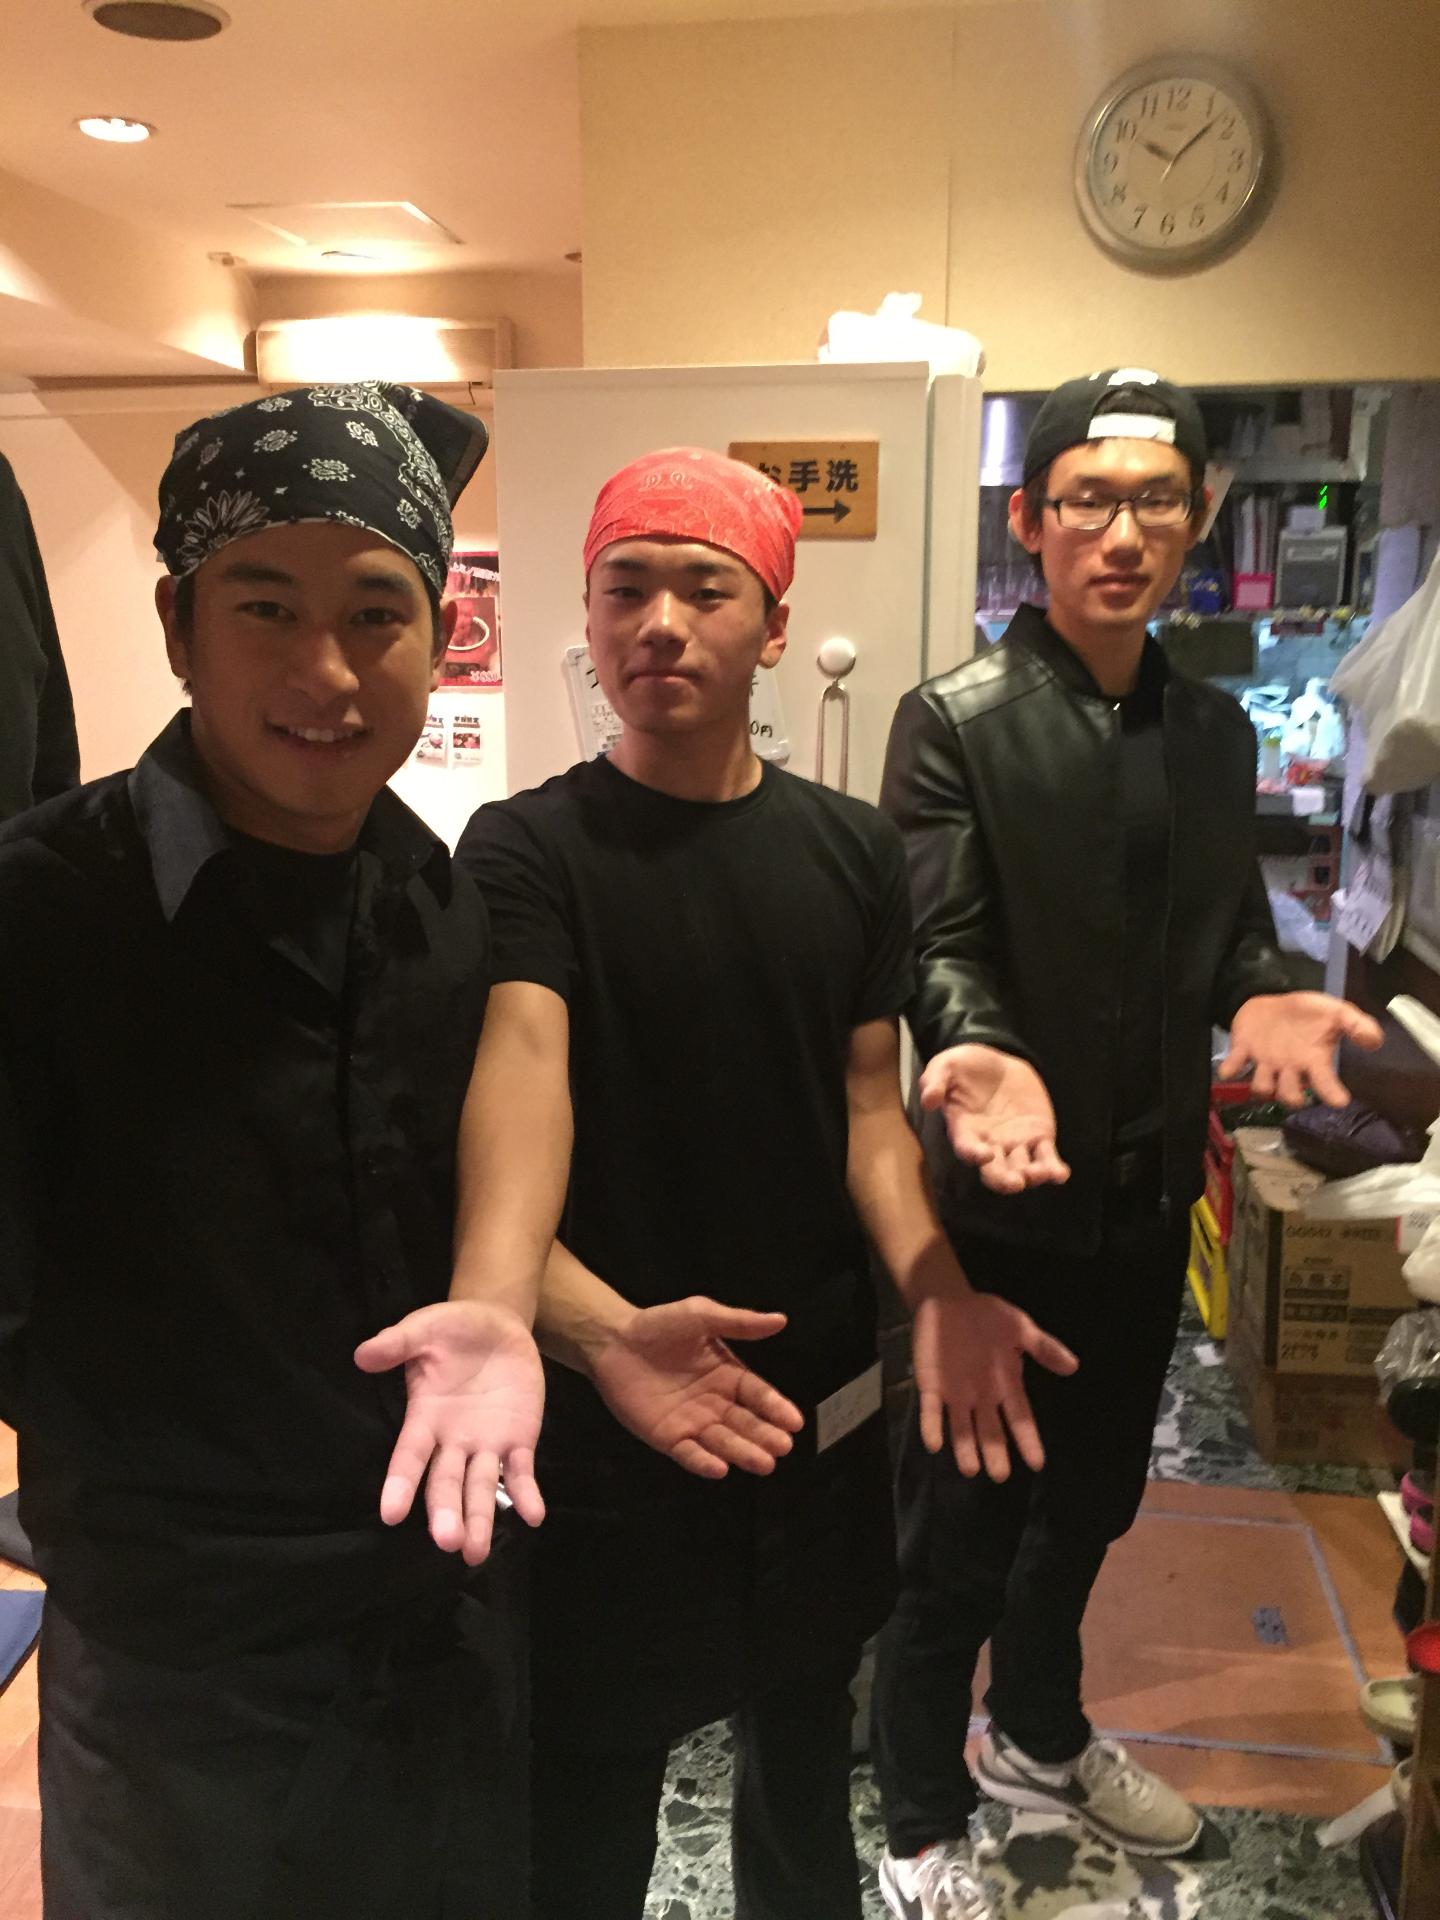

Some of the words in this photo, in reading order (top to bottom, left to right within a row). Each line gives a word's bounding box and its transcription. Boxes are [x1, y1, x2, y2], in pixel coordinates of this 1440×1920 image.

[1140, 93, 1159, 118] 11
[1167, 86, 1192, 111] 12
[1206, 92, 1217, 118] 1
[1115, 118, 1138, 144] 10
[1220, 113, 1237, 140] 2
[1103, 151, 1119, 175] 9
[1227, 147, 1245, 173] 3
[1108, 182, 1128, 206] 8
[1216, 181, 1230, 204] 4
[1134, 203, 1149, 229] 7
[1159, 211, 1175, 236] 6
[1188, 203, 1206, 229] 5
